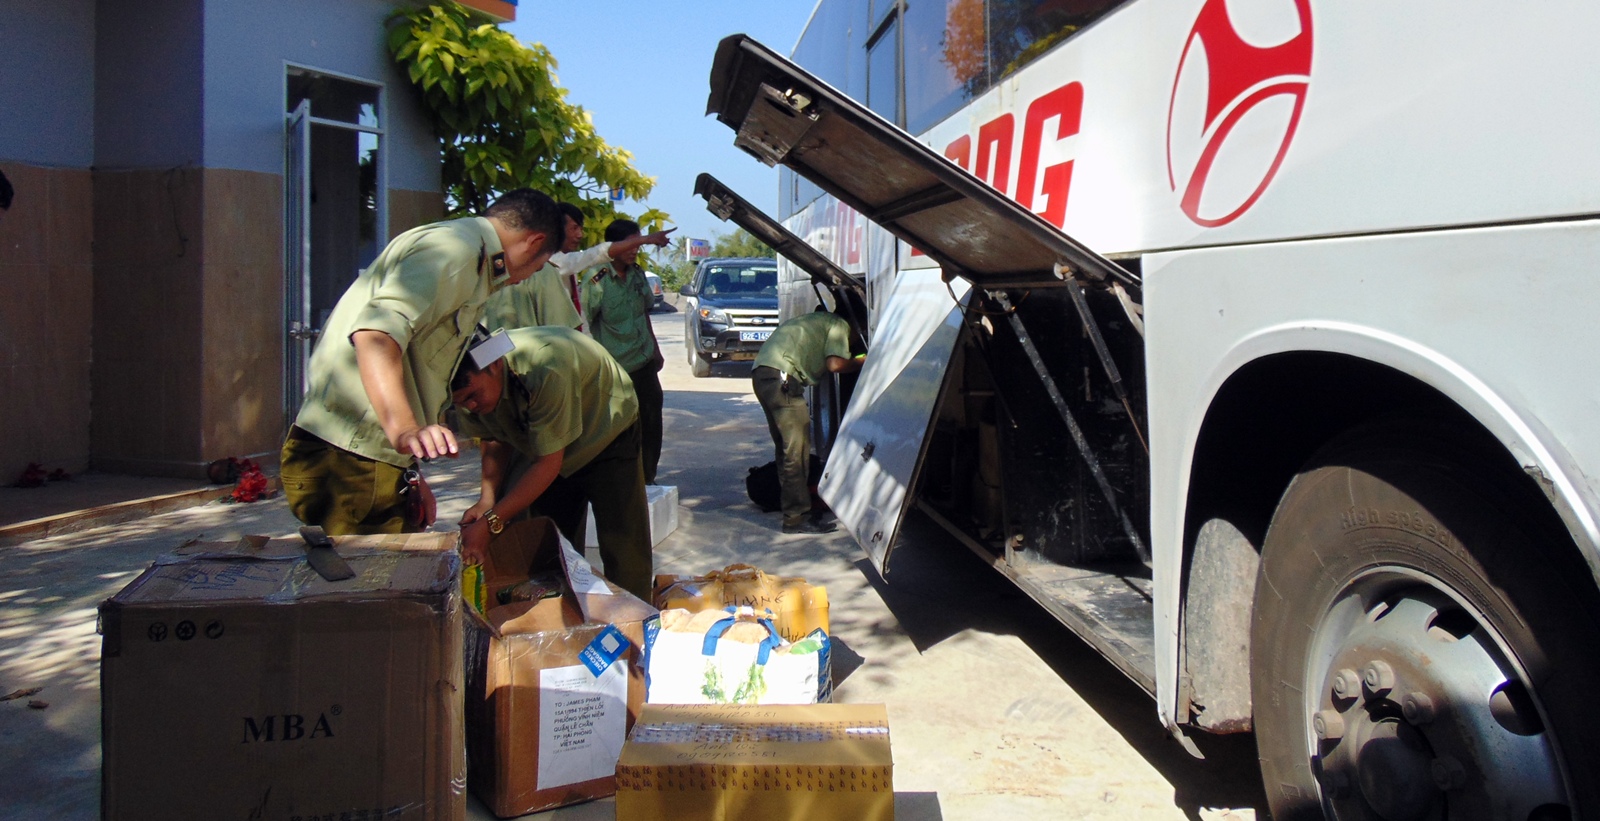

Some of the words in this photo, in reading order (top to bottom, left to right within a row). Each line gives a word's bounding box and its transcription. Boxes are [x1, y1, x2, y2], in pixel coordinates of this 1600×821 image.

[584, 650, 603, 671] CHECKED
[587, 645, 609, 669] BAGGAGE
[240, 711, 335, 744] MBA
